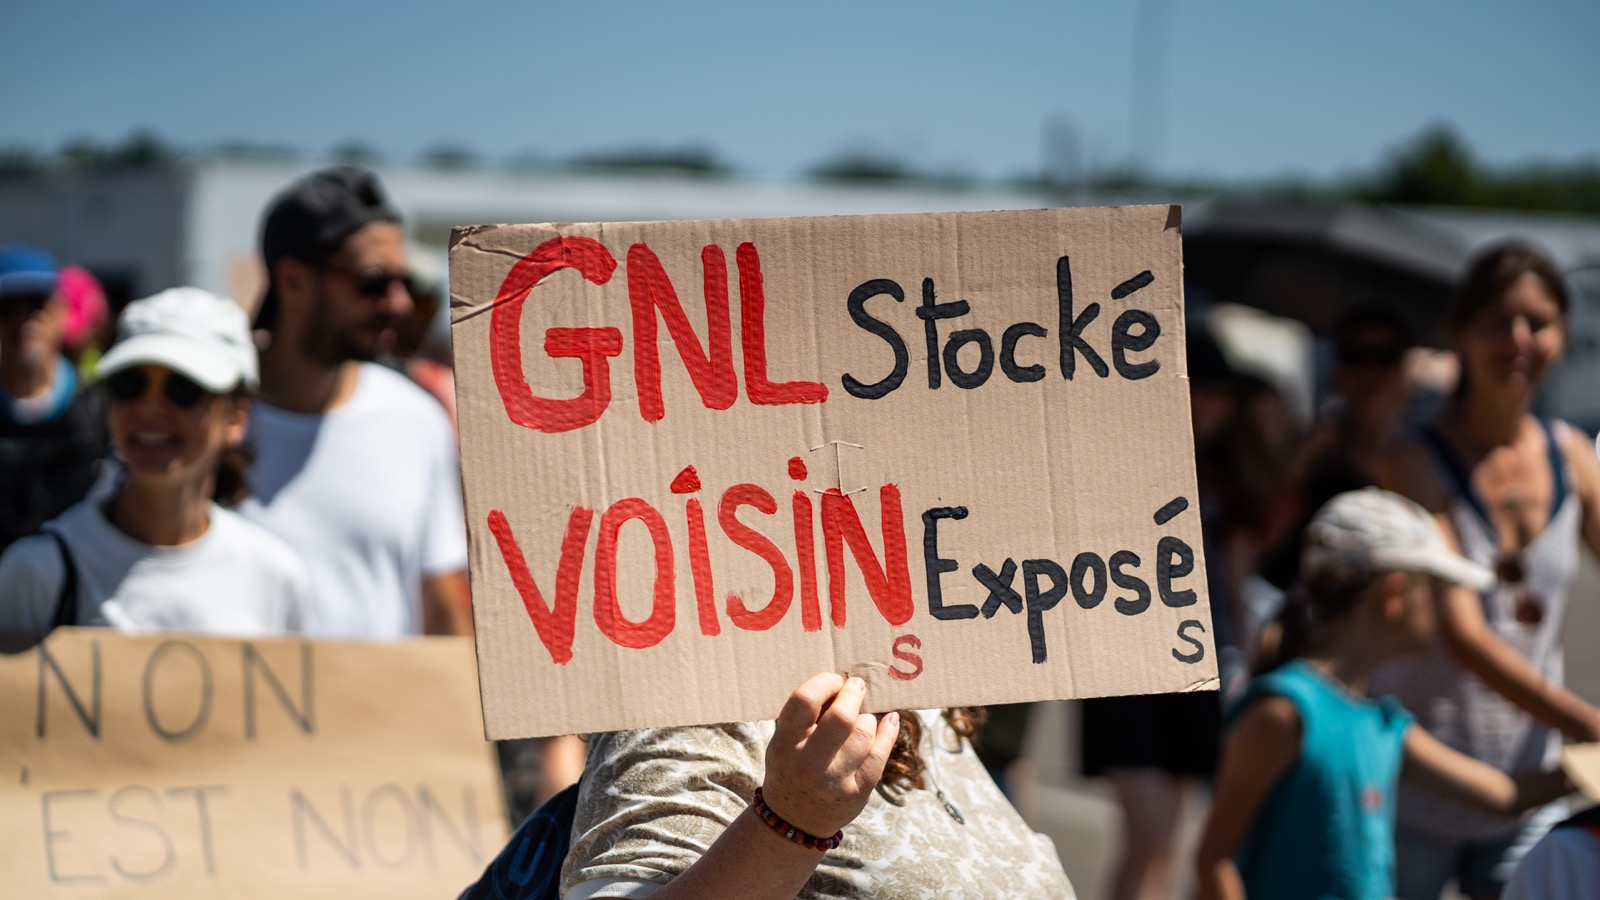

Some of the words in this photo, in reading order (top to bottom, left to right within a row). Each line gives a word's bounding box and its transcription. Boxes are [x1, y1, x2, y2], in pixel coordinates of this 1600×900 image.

[489, 235, 829, 433] GNL
[841, 255, 1161, 399] Stocké
[922, 496, 1198, 664] Exposé
[35, 638, 315, 742] NON
[289, 782, 487, 873] NON
